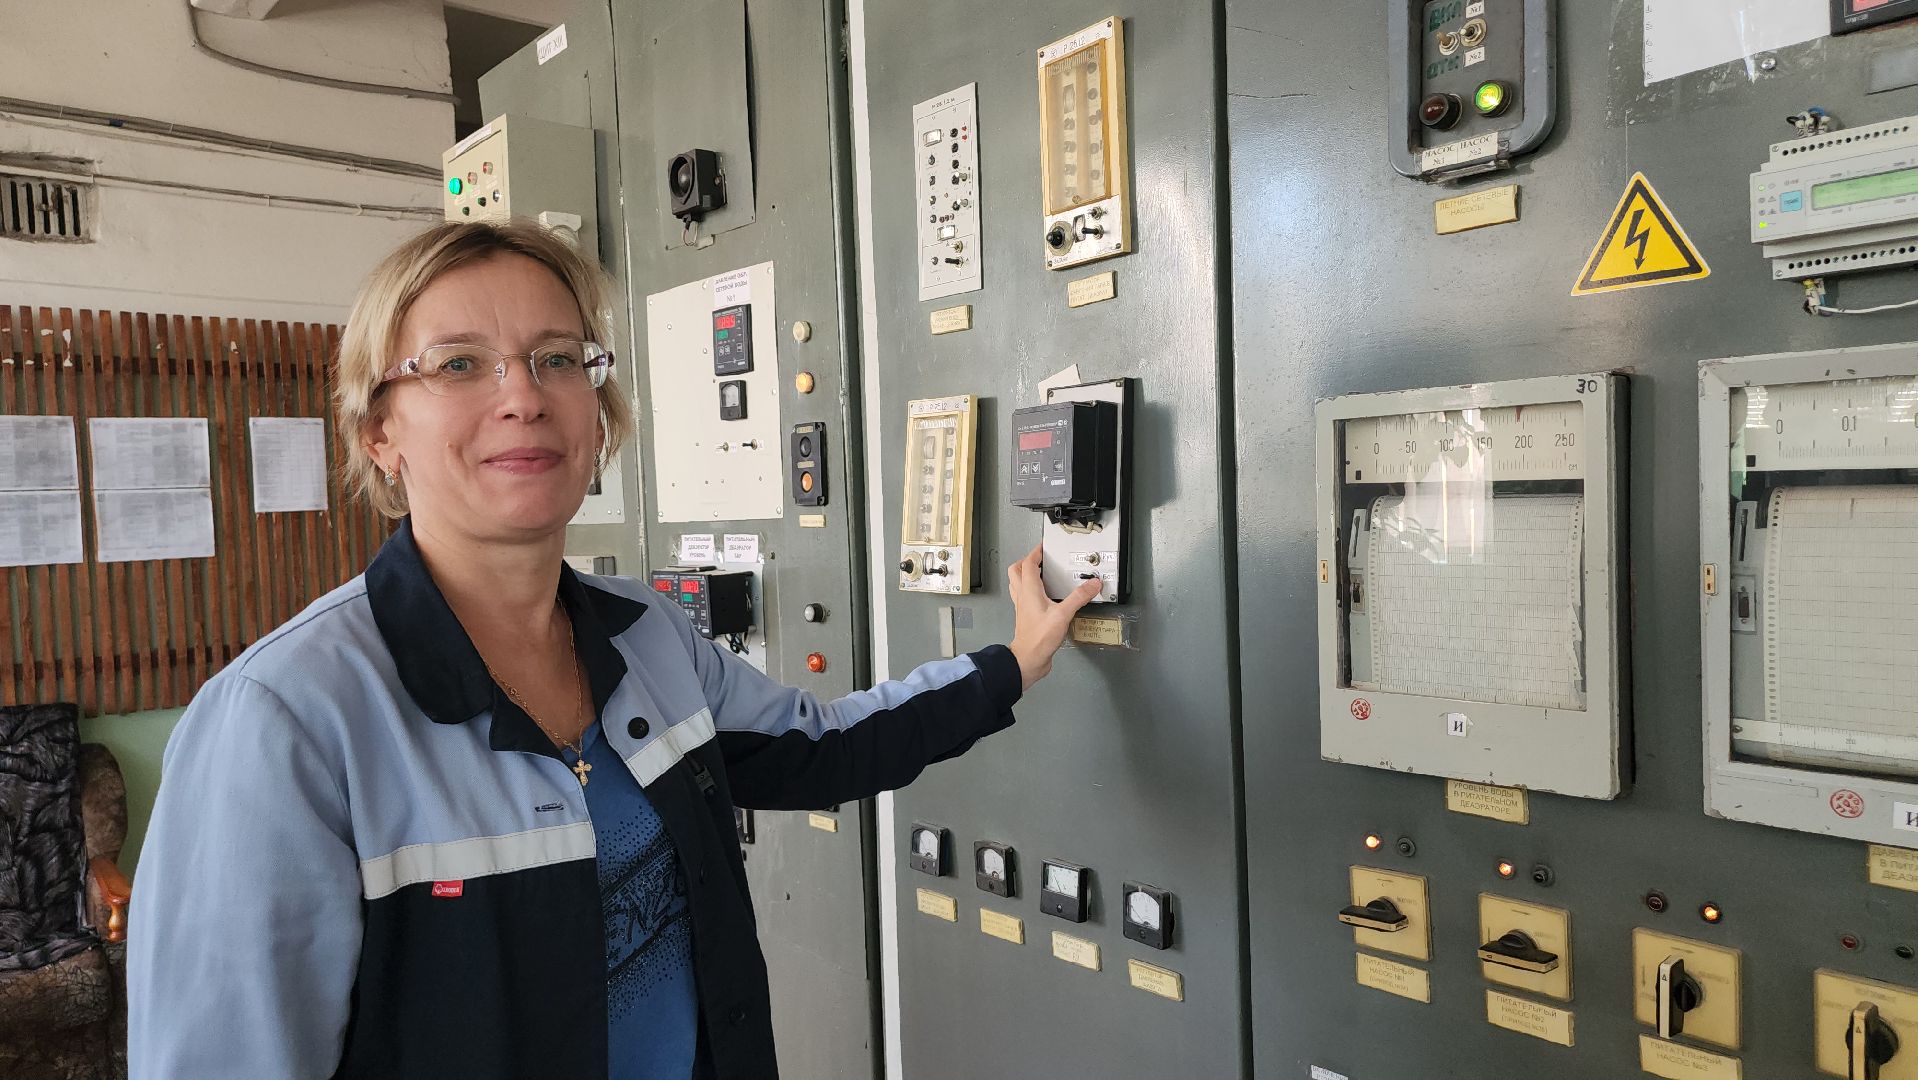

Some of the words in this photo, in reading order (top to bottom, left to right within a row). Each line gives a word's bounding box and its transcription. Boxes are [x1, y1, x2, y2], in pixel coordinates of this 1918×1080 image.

[1469, 51, 1482, 62] №2
[1460, 135, 1493, 149] НАСОС
[1425, 144, 1456, 158] НАСОС
[1776, 419, 1784, 435] 0
[1374, 442, 1380, 455] 0
[1405, 440, 1417, 454] 50
[1514, 434, 1534, 449] 200
[1554, 432, 1575, 448] 250
[1453, 720, 1464, 733] И
[1454, 781, 1489, 794] УРОВЕНЬ
[1490, 787, 1515, 798] ВОДЫ
[1460, 791, 1518, 807] ПИТАТЕЛЬНОМ
[1460, 799, 1511, 815] ДЕАЭРАТОРЕ
[1363, 957, 1416, 977] ПИТАТЕЛЬНЫЙ
[1496, 995, 1558, 1019] ПИТАТЕЛЬНЫЙ
[1501, 1006, 1531, 1020] НАСОС
[1650, 1041, 1722, 1066] ПИТАТЕЛЬНЫЙ
